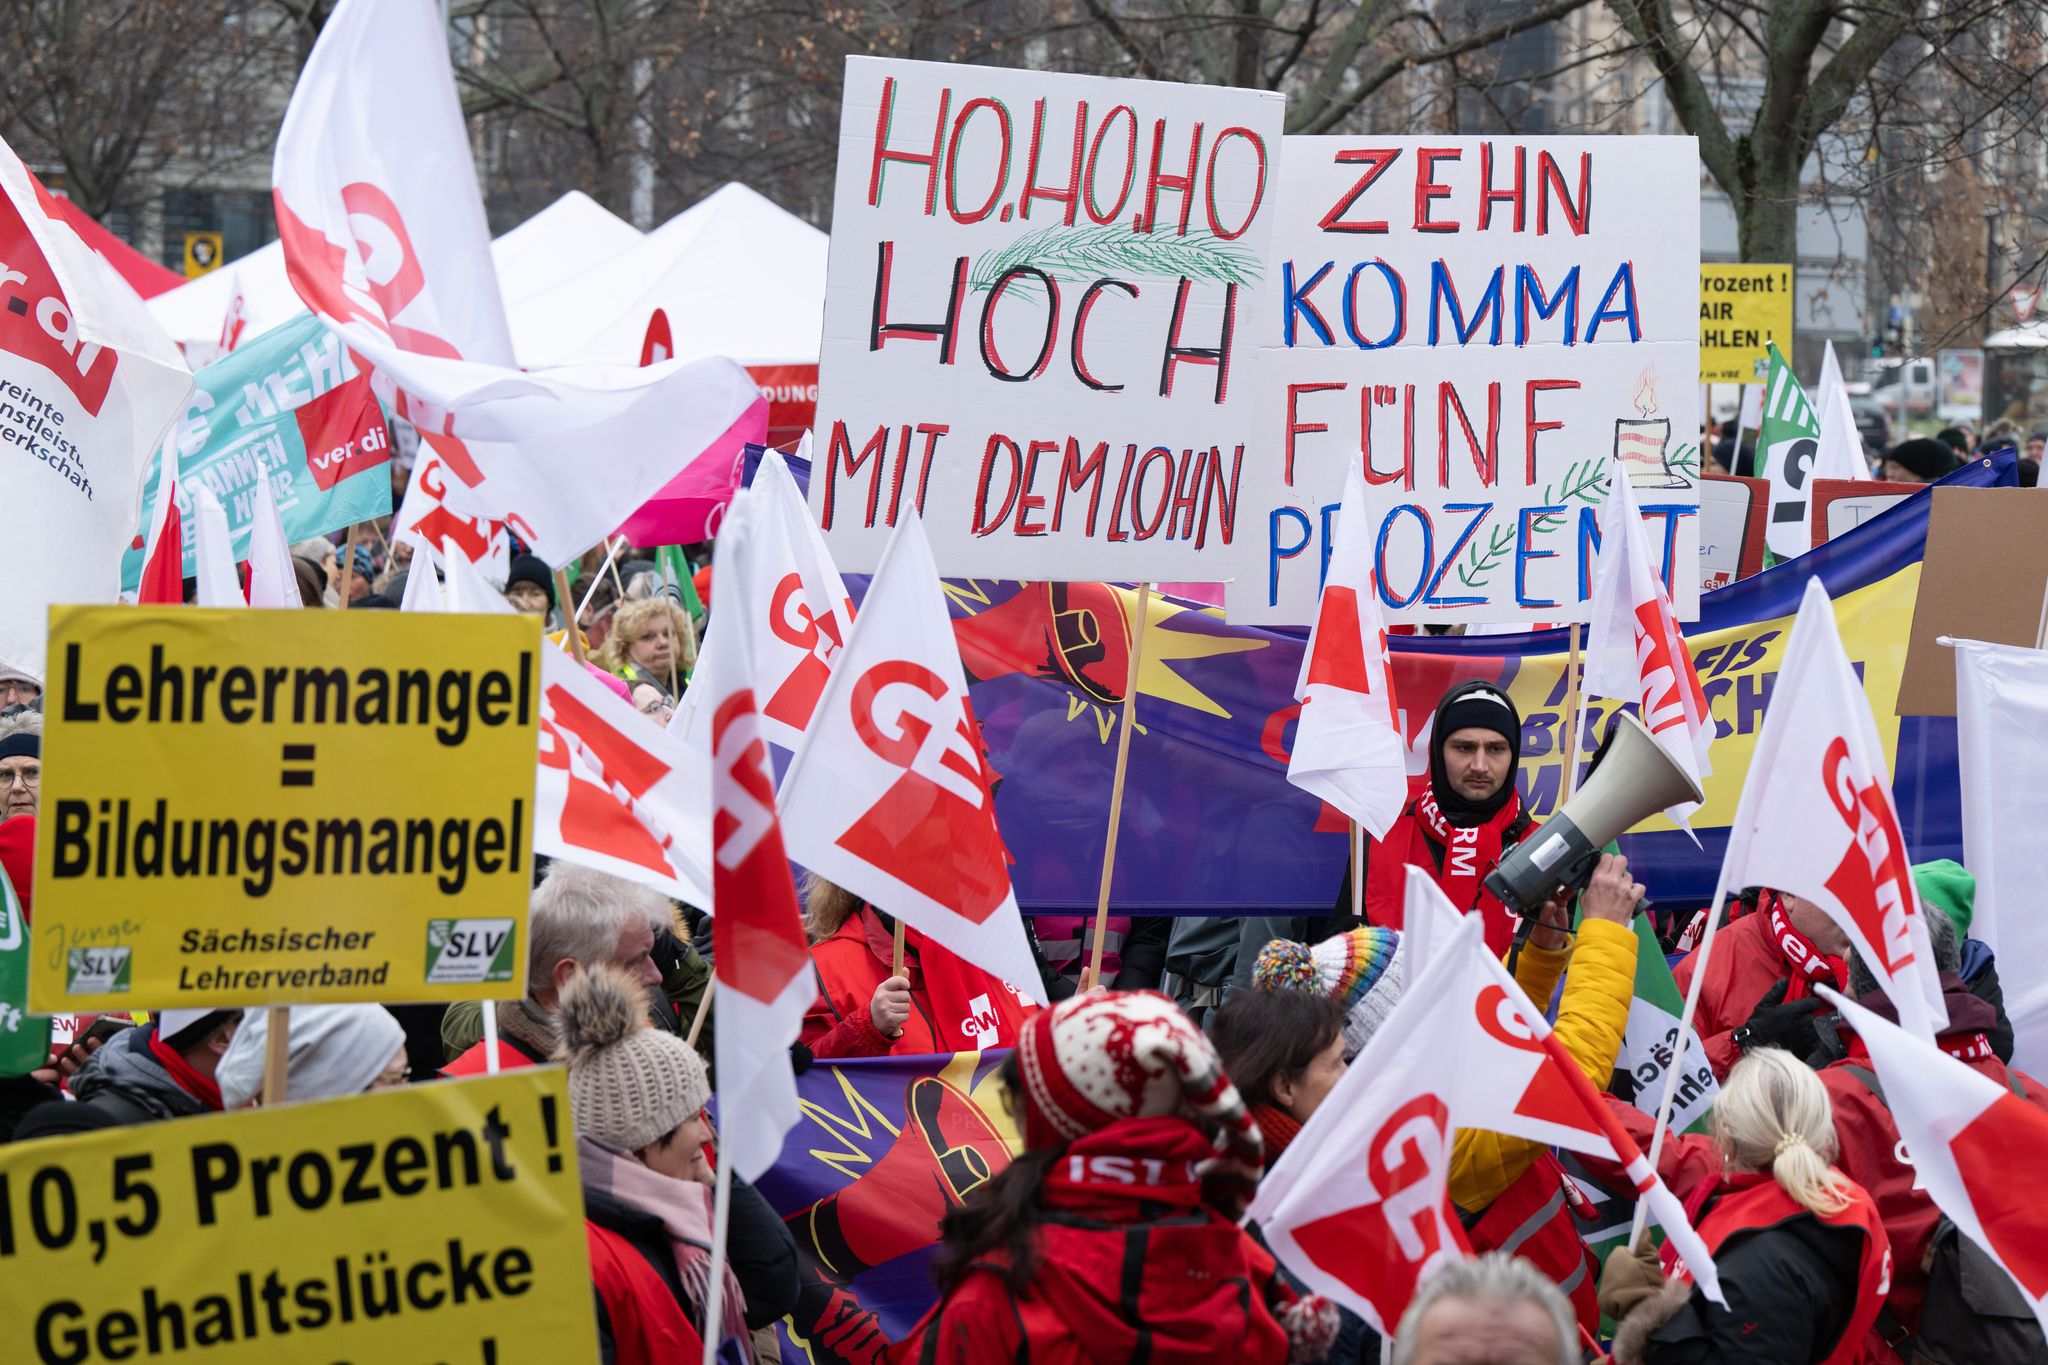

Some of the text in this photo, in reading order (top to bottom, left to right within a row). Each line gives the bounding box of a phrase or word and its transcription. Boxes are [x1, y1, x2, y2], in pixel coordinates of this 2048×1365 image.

[1317, 141, 1593, 237] ZEHN
[869, 241, 1239, 404] HOCH
[1282, 257, 1642, 350] KOMMA
[1700, 273, 1774, 293] rozent
[1700, 330, 1760, 348] HLEN
[313, 426, 388, 470] ver.di
[821, 418, 950, 532] MIT
[1284, 379, 1582, 492] FÜNF
[63, 642, 532, 747] Lehrermangel
[52, 797, 524, 898] Bildungsmangel
[82, 954, 126, 976] SLV
[178, 961, 389, 991] Lehrerverband
[179, 928, 377, 954] Sächsischer
[447, 931, 505, 958] SLV
[191, 1106, 515, 1227] Prozent
[34, 1239, 534, 1365] Gehaltslücke
